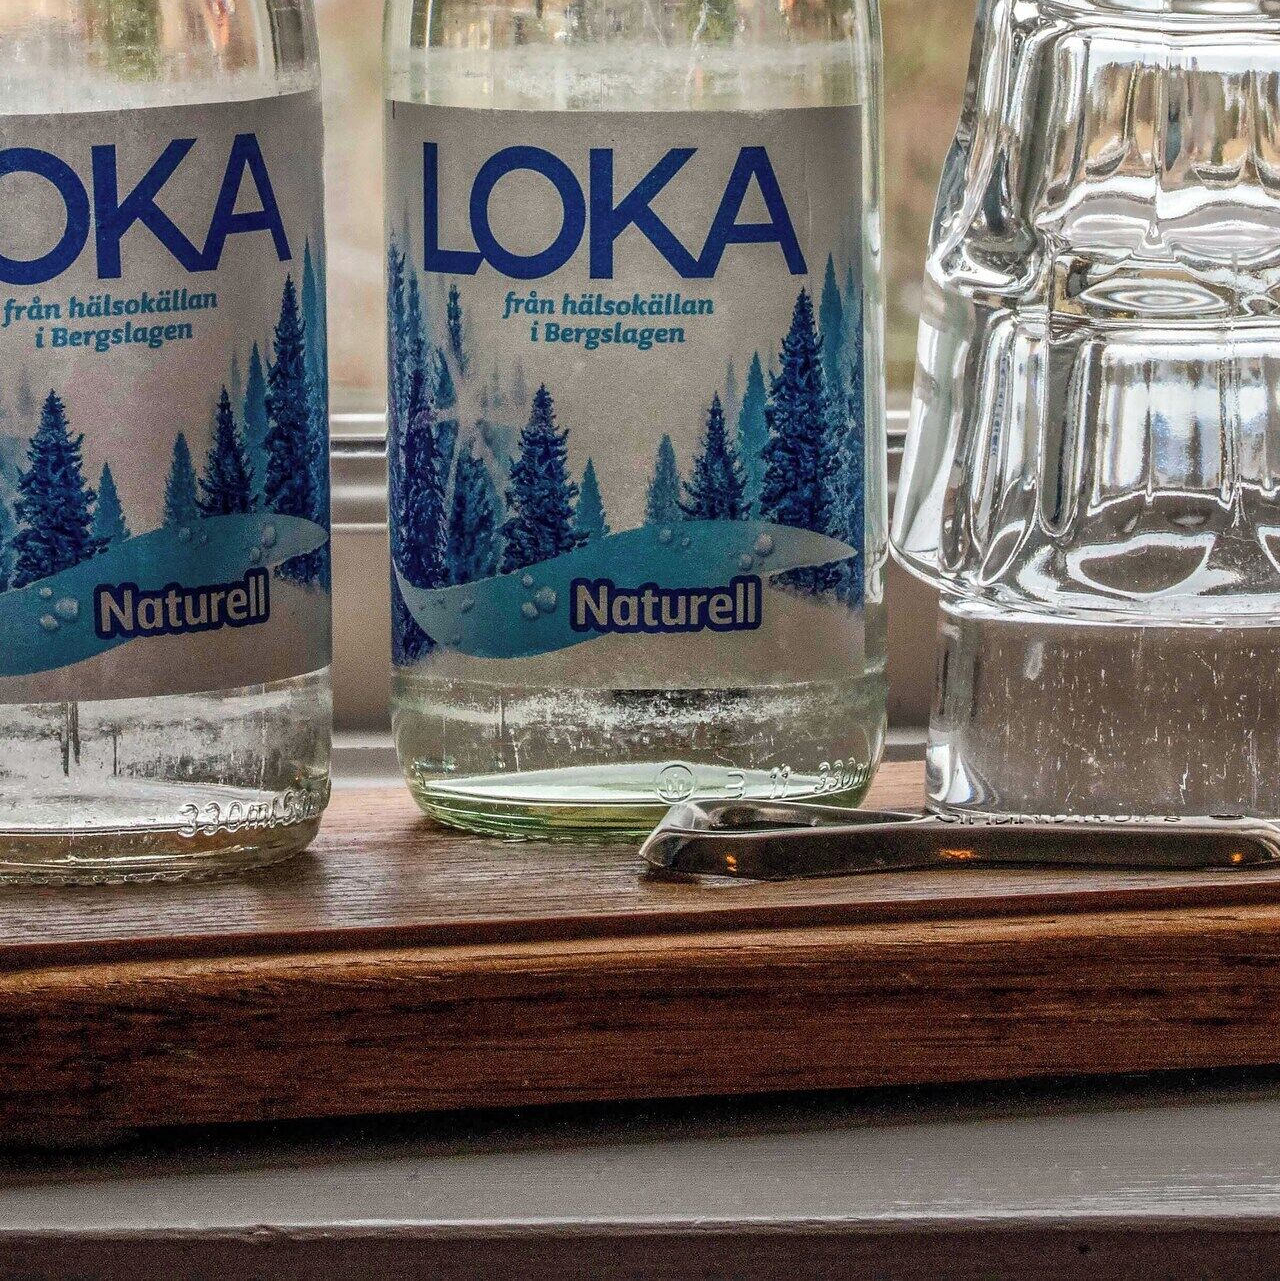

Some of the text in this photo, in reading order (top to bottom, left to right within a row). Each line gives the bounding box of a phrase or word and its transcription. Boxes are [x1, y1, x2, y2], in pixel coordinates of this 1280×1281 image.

[423, 141, 808, 280] LOKA
[2, 287, 217, 328] från hälsokällan
[502, 290, 714, 319] från hälsokällan
[35, 321, 194, 353] i Bergslagen
[530, 321, 685, 351] i Bergslagen
[100, 574, 266, 633] Naturell
[576, 582, 756, 627] Naturell
